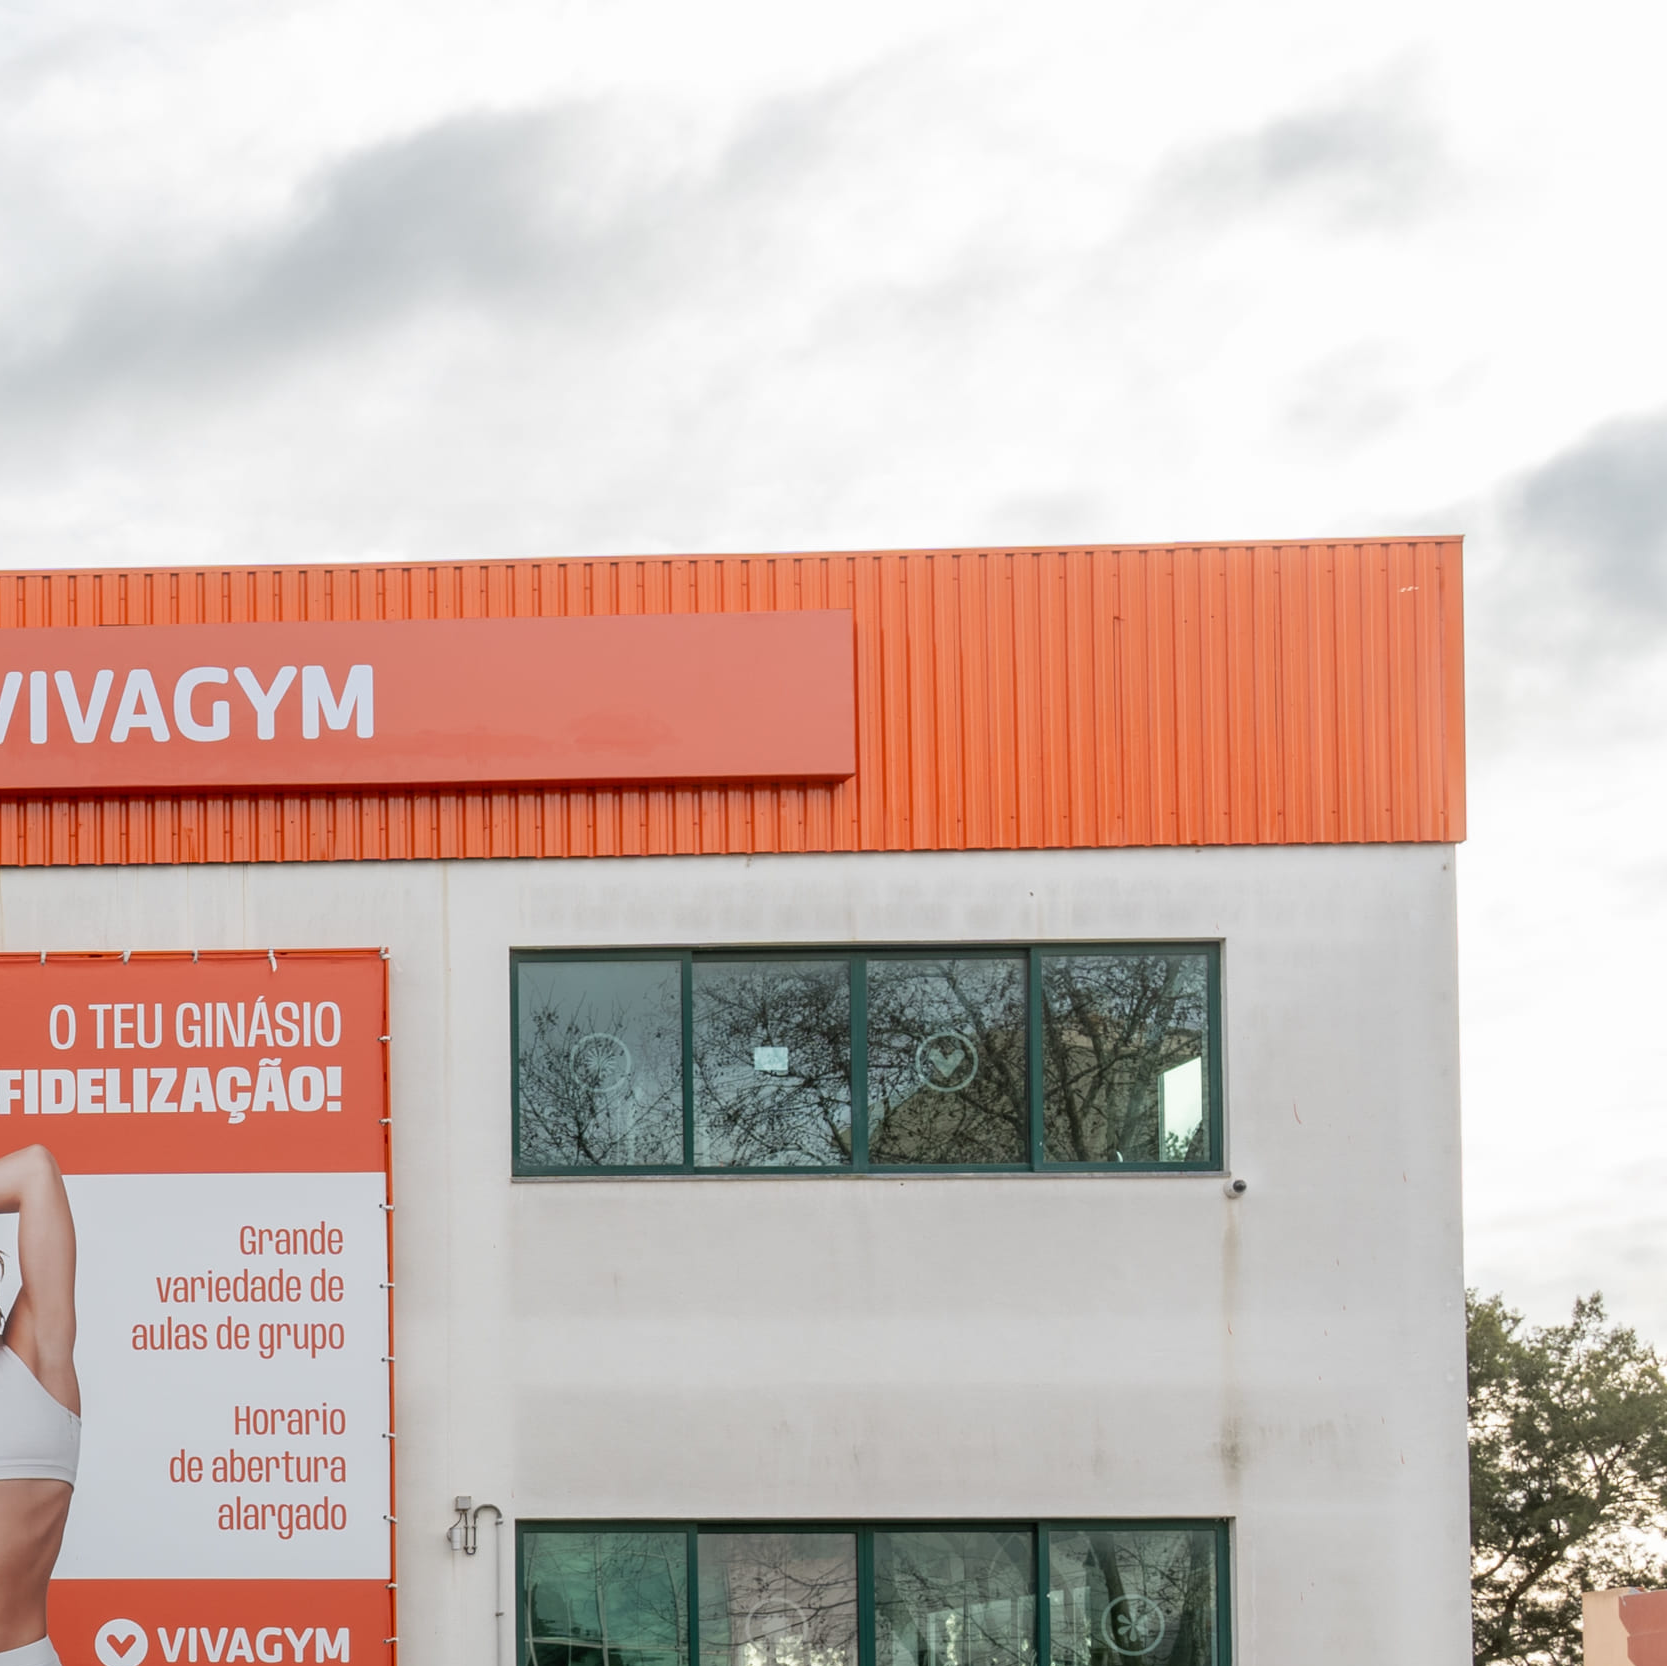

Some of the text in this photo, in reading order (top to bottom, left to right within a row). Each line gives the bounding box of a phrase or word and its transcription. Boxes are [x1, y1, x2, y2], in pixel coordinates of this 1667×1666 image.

[49, 995, 342, 1050] O TEU GINÁSIO
[239, 1221, 344, 1255] Grande
[156, 1268, 344, 1303] variedade de
[131, 1315, 345, 1359] aulas de grupo
[234, 1402, 346, 1436] Horario
[169, 1448, 346, 1483] de abertura
[218, 1495, 347, 1540] alargado
[157, 1626, 350, 1663] VIVAGYM
